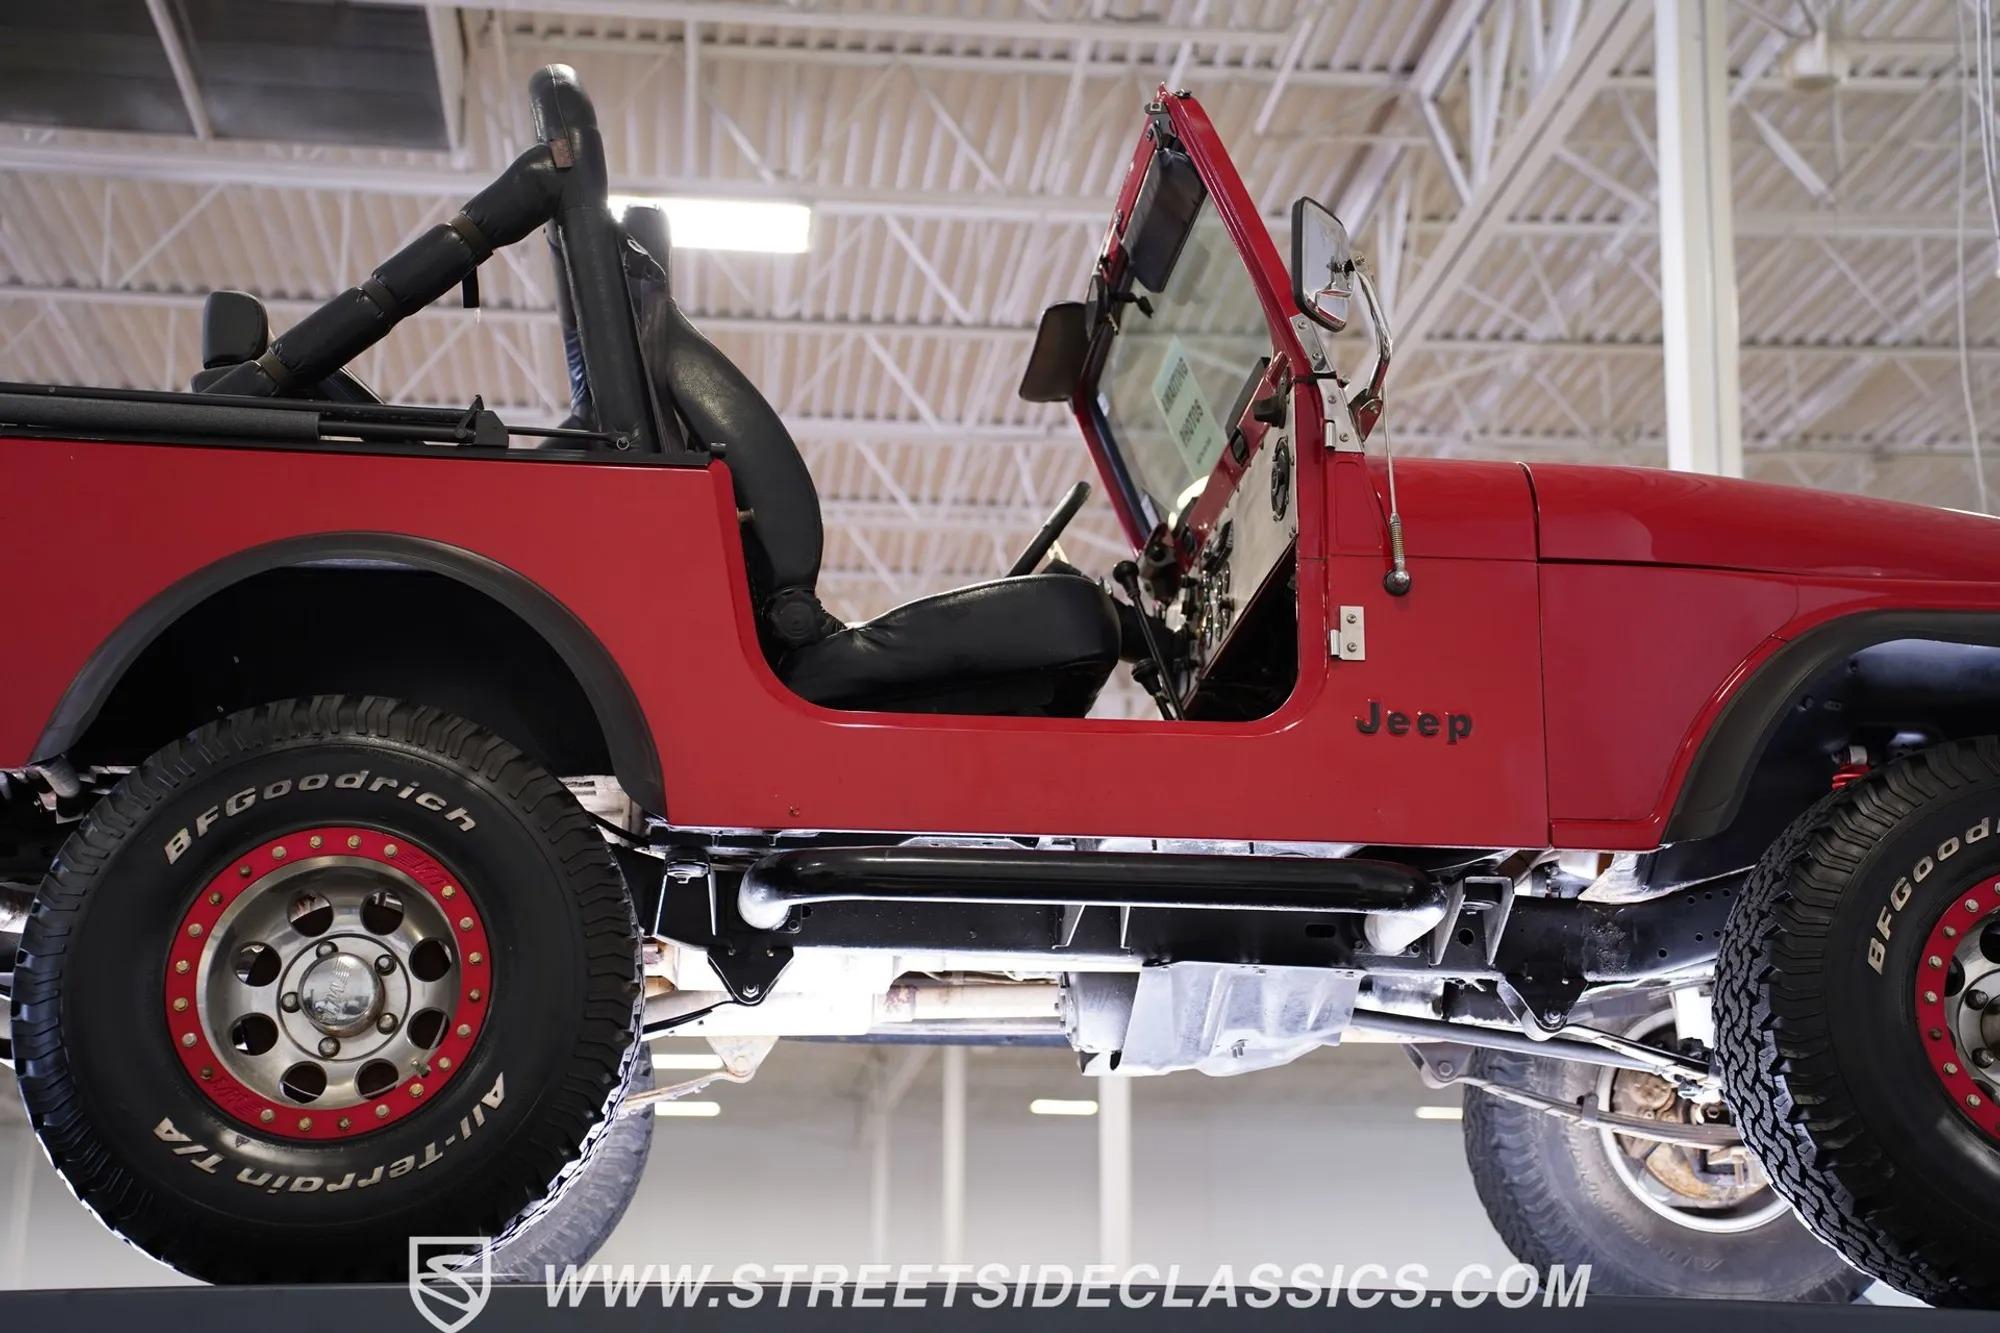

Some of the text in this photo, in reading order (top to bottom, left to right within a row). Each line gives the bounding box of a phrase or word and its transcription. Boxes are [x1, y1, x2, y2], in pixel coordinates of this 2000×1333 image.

[1179, 399, 1204, 448] PHOTOS
[1355, 699, 1473, 745] Jeep
[164, 769, 477, 865] BFGoodrich
[153, 1115, 219, 1176] T/A
[236, 1071, 506, 1194] All-Terrain
